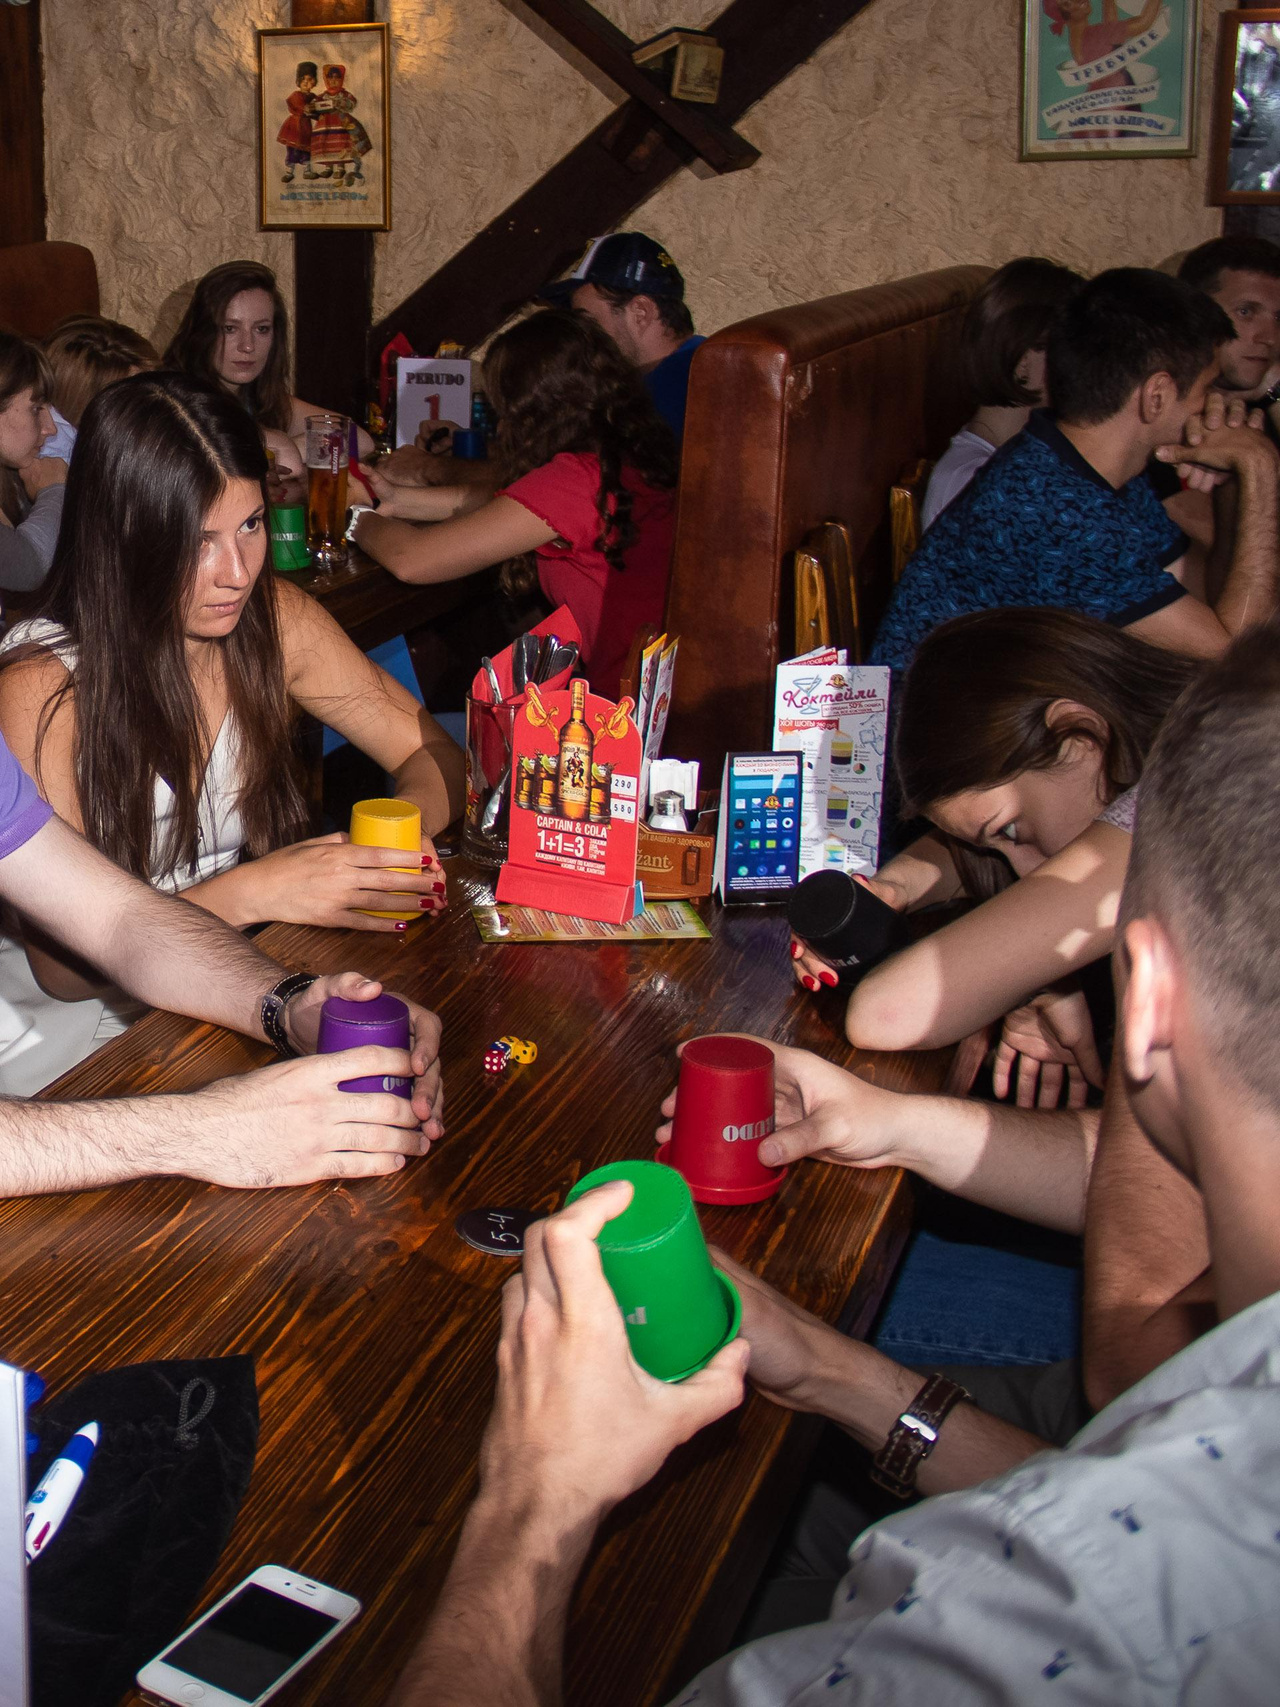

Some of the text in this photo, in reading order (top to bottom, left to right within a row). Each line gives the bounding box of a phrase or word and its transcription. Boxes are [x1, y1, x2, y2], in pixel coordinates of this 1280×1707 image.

[405, 372, 465, 386] PERUDO
[424, 393, 440, 421] 1
[782, 687, 877, 708] Коктейли
[614, 779, 632, 789] 290
[614, 803, 632, 814] 580
[536, 815, 608, 839] CAPTAIN & COLA
[537, 829, 586, 858] 1+1=3
[650, 835, 676, 844] ВАШЕМУ
[677, 837, 711, 848] ЗДОРОВЬЮ
